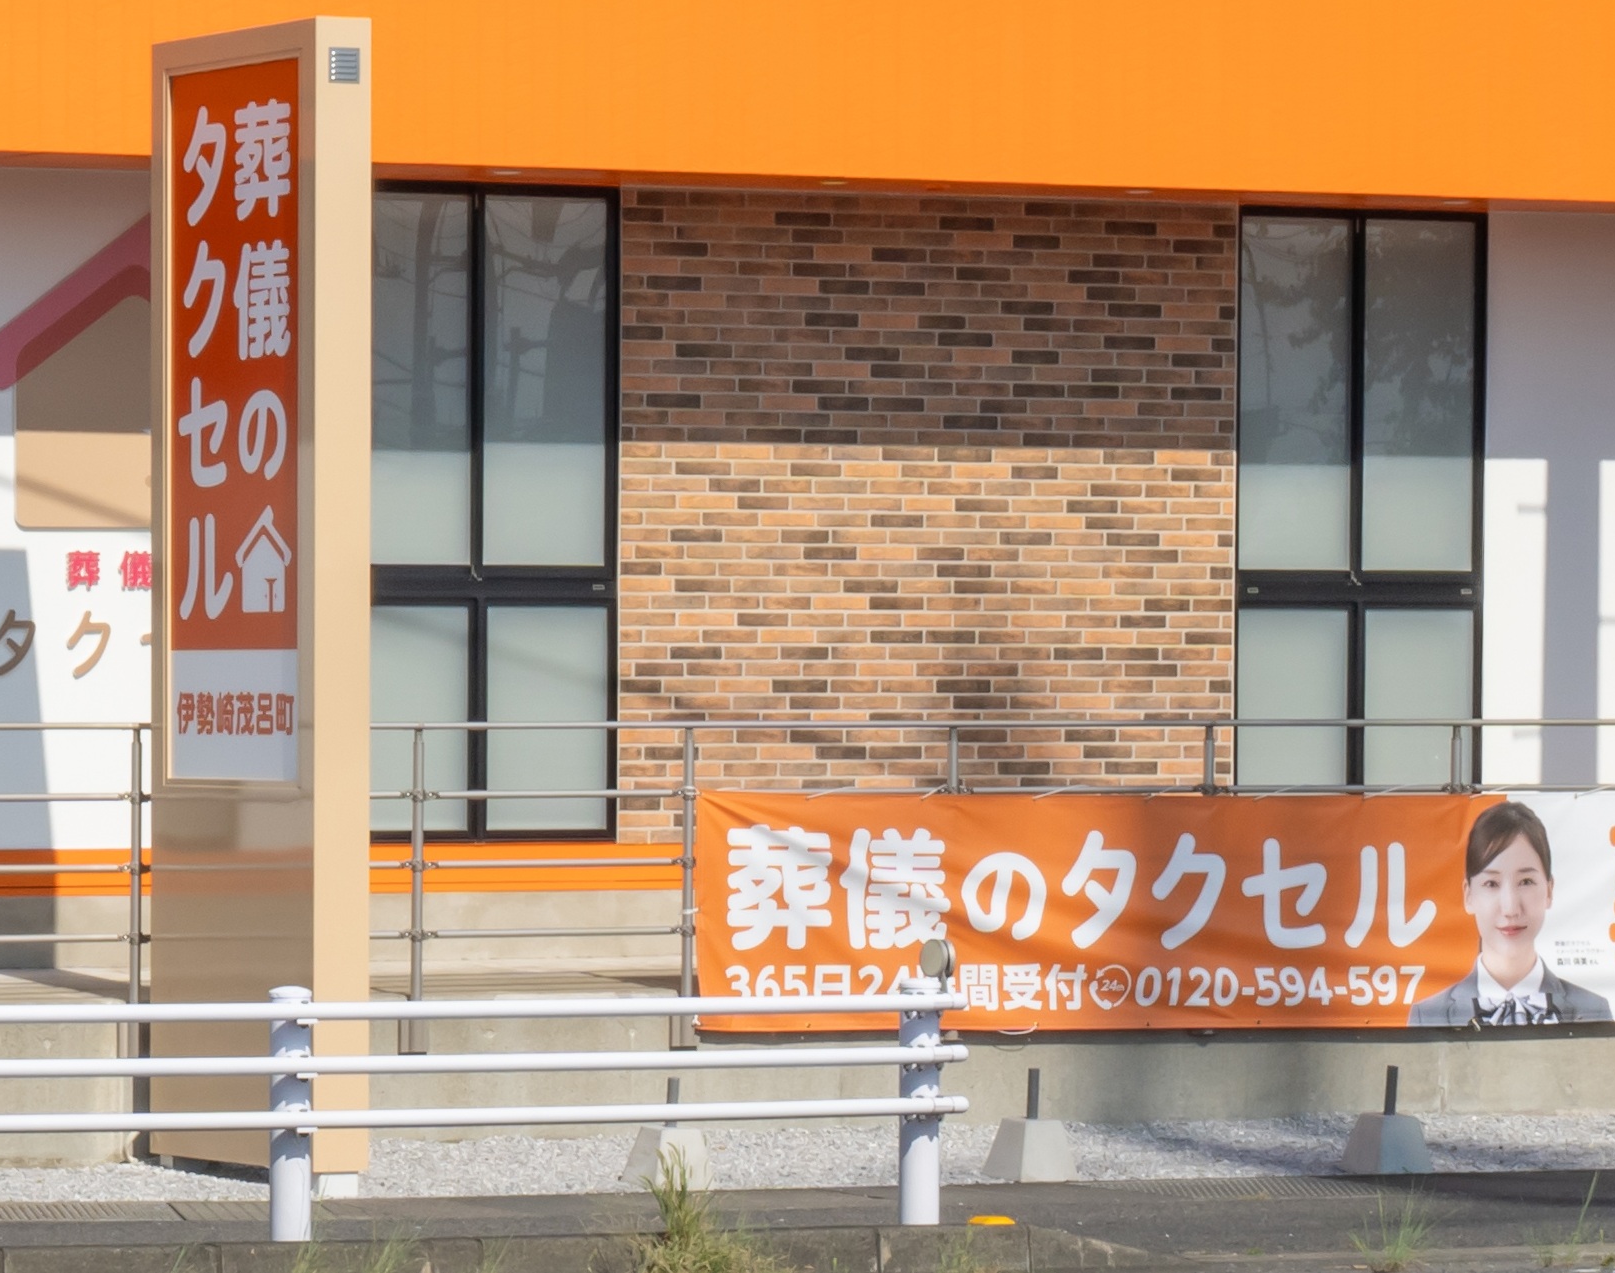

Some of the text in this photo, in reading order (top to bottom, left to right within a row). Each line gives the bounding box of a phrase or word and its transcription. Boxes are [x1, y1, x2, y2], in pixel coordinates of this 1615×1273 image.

[233, 98, 291, 480] 葬儀の
[178, 105, 234, 620] タクセル
[177, 691, 295, 736] 伊勢崎茂呂町
[726, 824, 1437, 950] 葬儀のタクセル
[1134, 965, 1426, 1007] 0120-594-597
